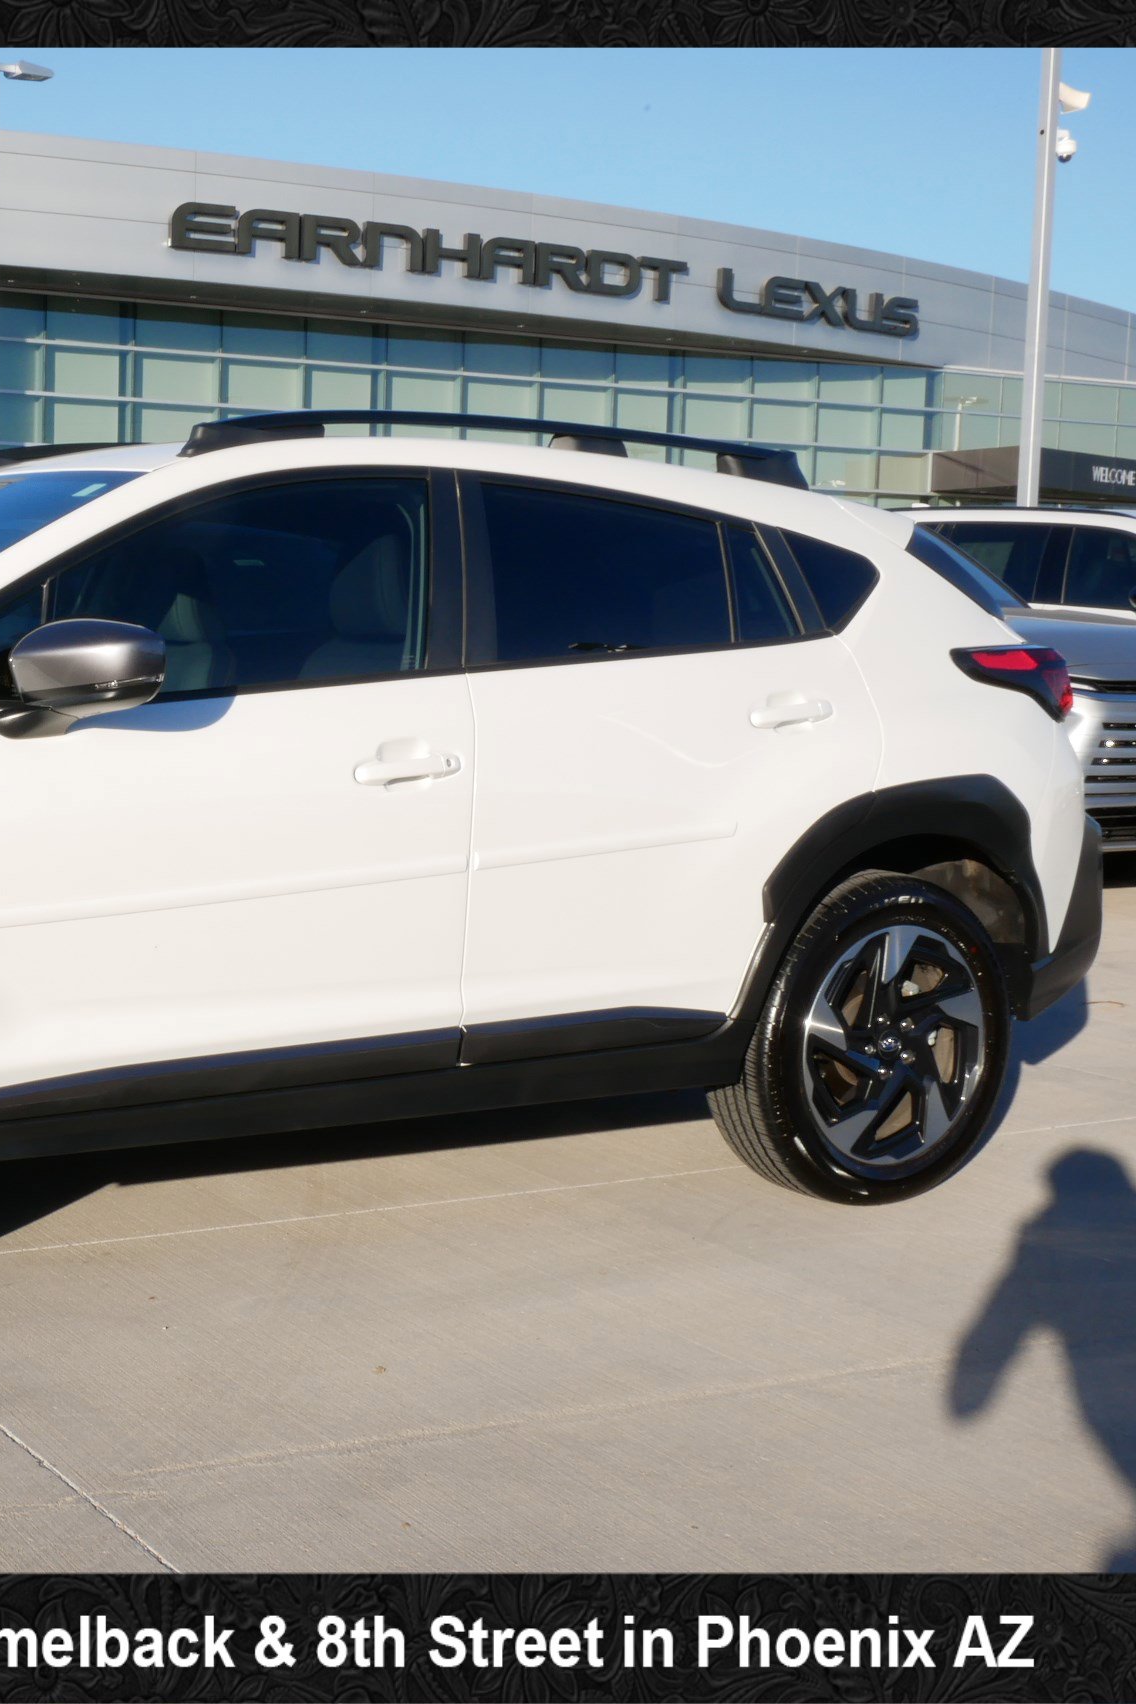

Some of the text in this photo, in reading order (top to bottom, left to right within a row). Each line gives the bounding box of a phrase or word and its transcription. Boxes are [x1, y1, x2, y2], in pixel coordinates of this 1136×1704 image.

[168, 202, 919, 337] EARNHARDT LEXUS
[1092, 465, 1136, 486] WELCOME
